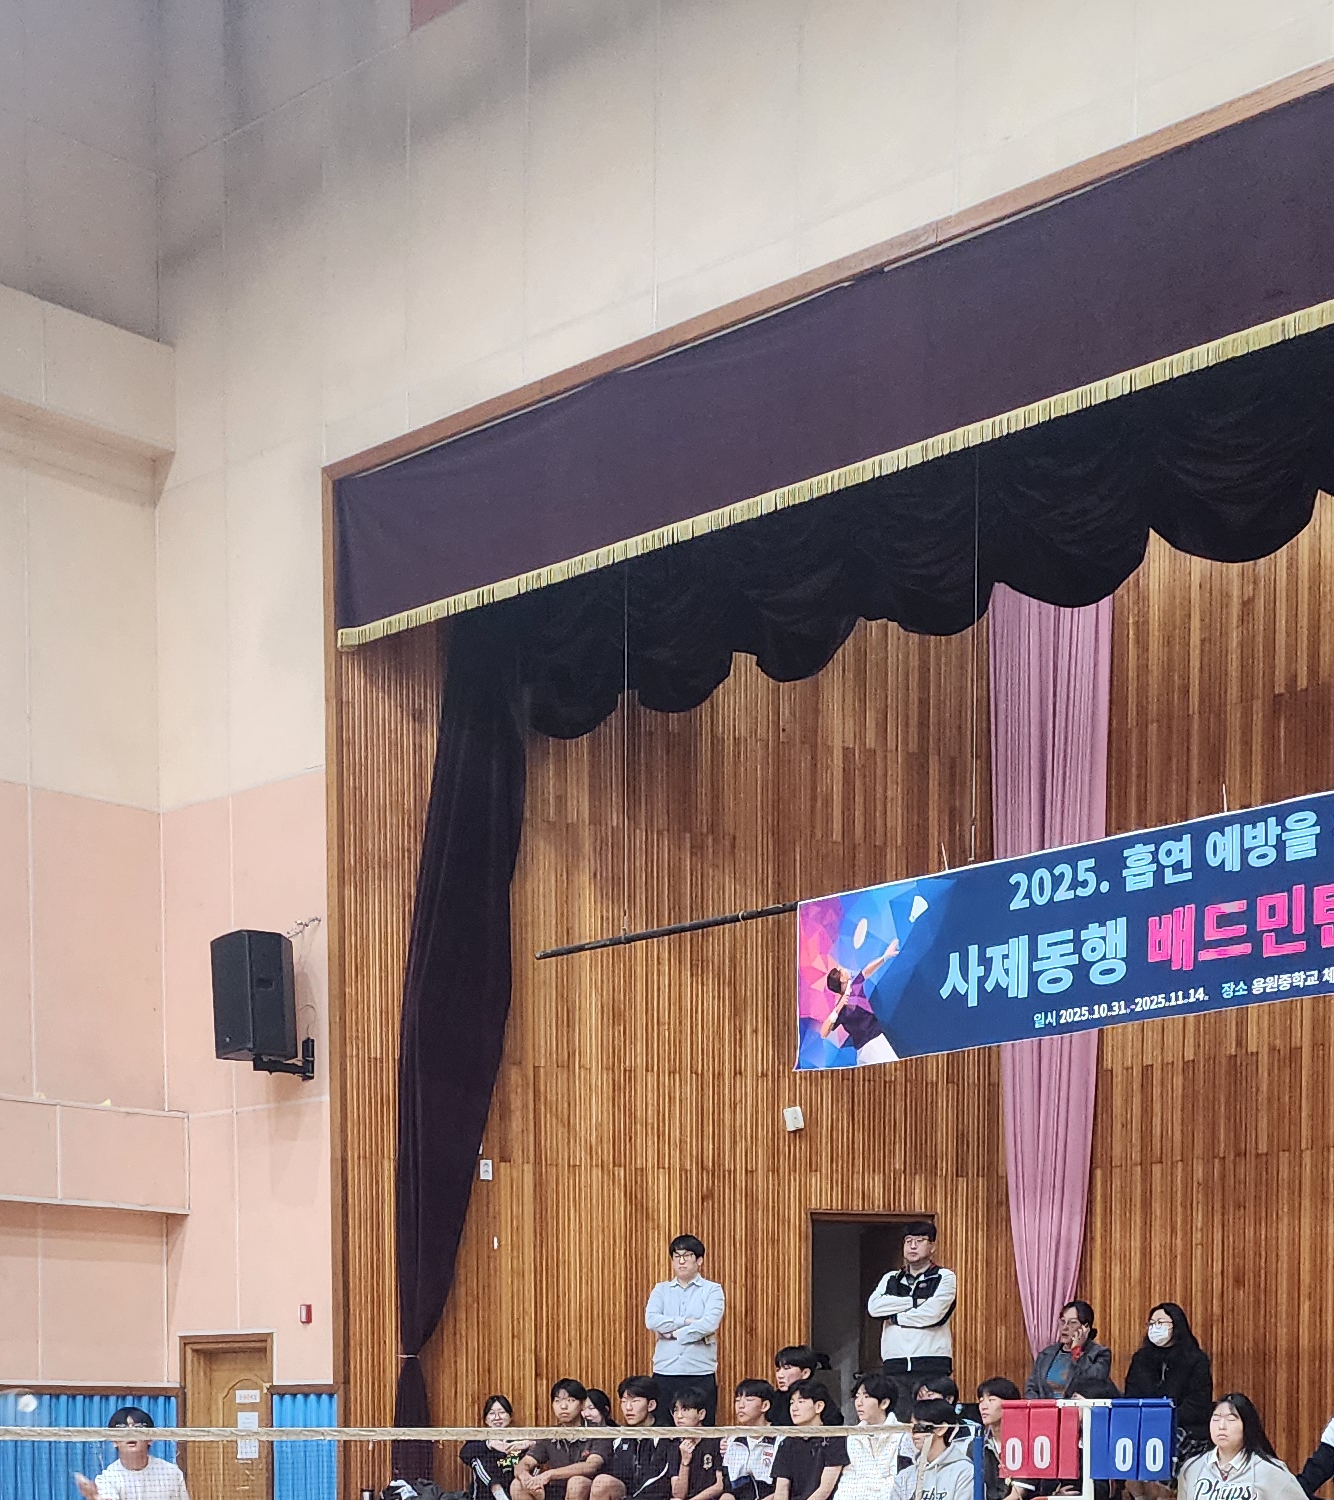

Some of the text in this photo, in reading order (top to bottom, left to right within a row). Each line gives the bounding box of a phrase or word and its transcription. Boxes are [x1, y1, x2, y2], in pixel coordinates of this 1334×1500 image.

[1008, 858, 1110, 911] 2025.
[1122, 834, 1193, 893] 흡연
[1205, 810, 1321, 872] 예방을
[939, 916, 1128, 1008] 사제동행
[1033, 1010, 1057, 1029] 일시
[1221, 981, 1248, 999] 장소
[1251, 970, 1320, 995] 용원중학교
